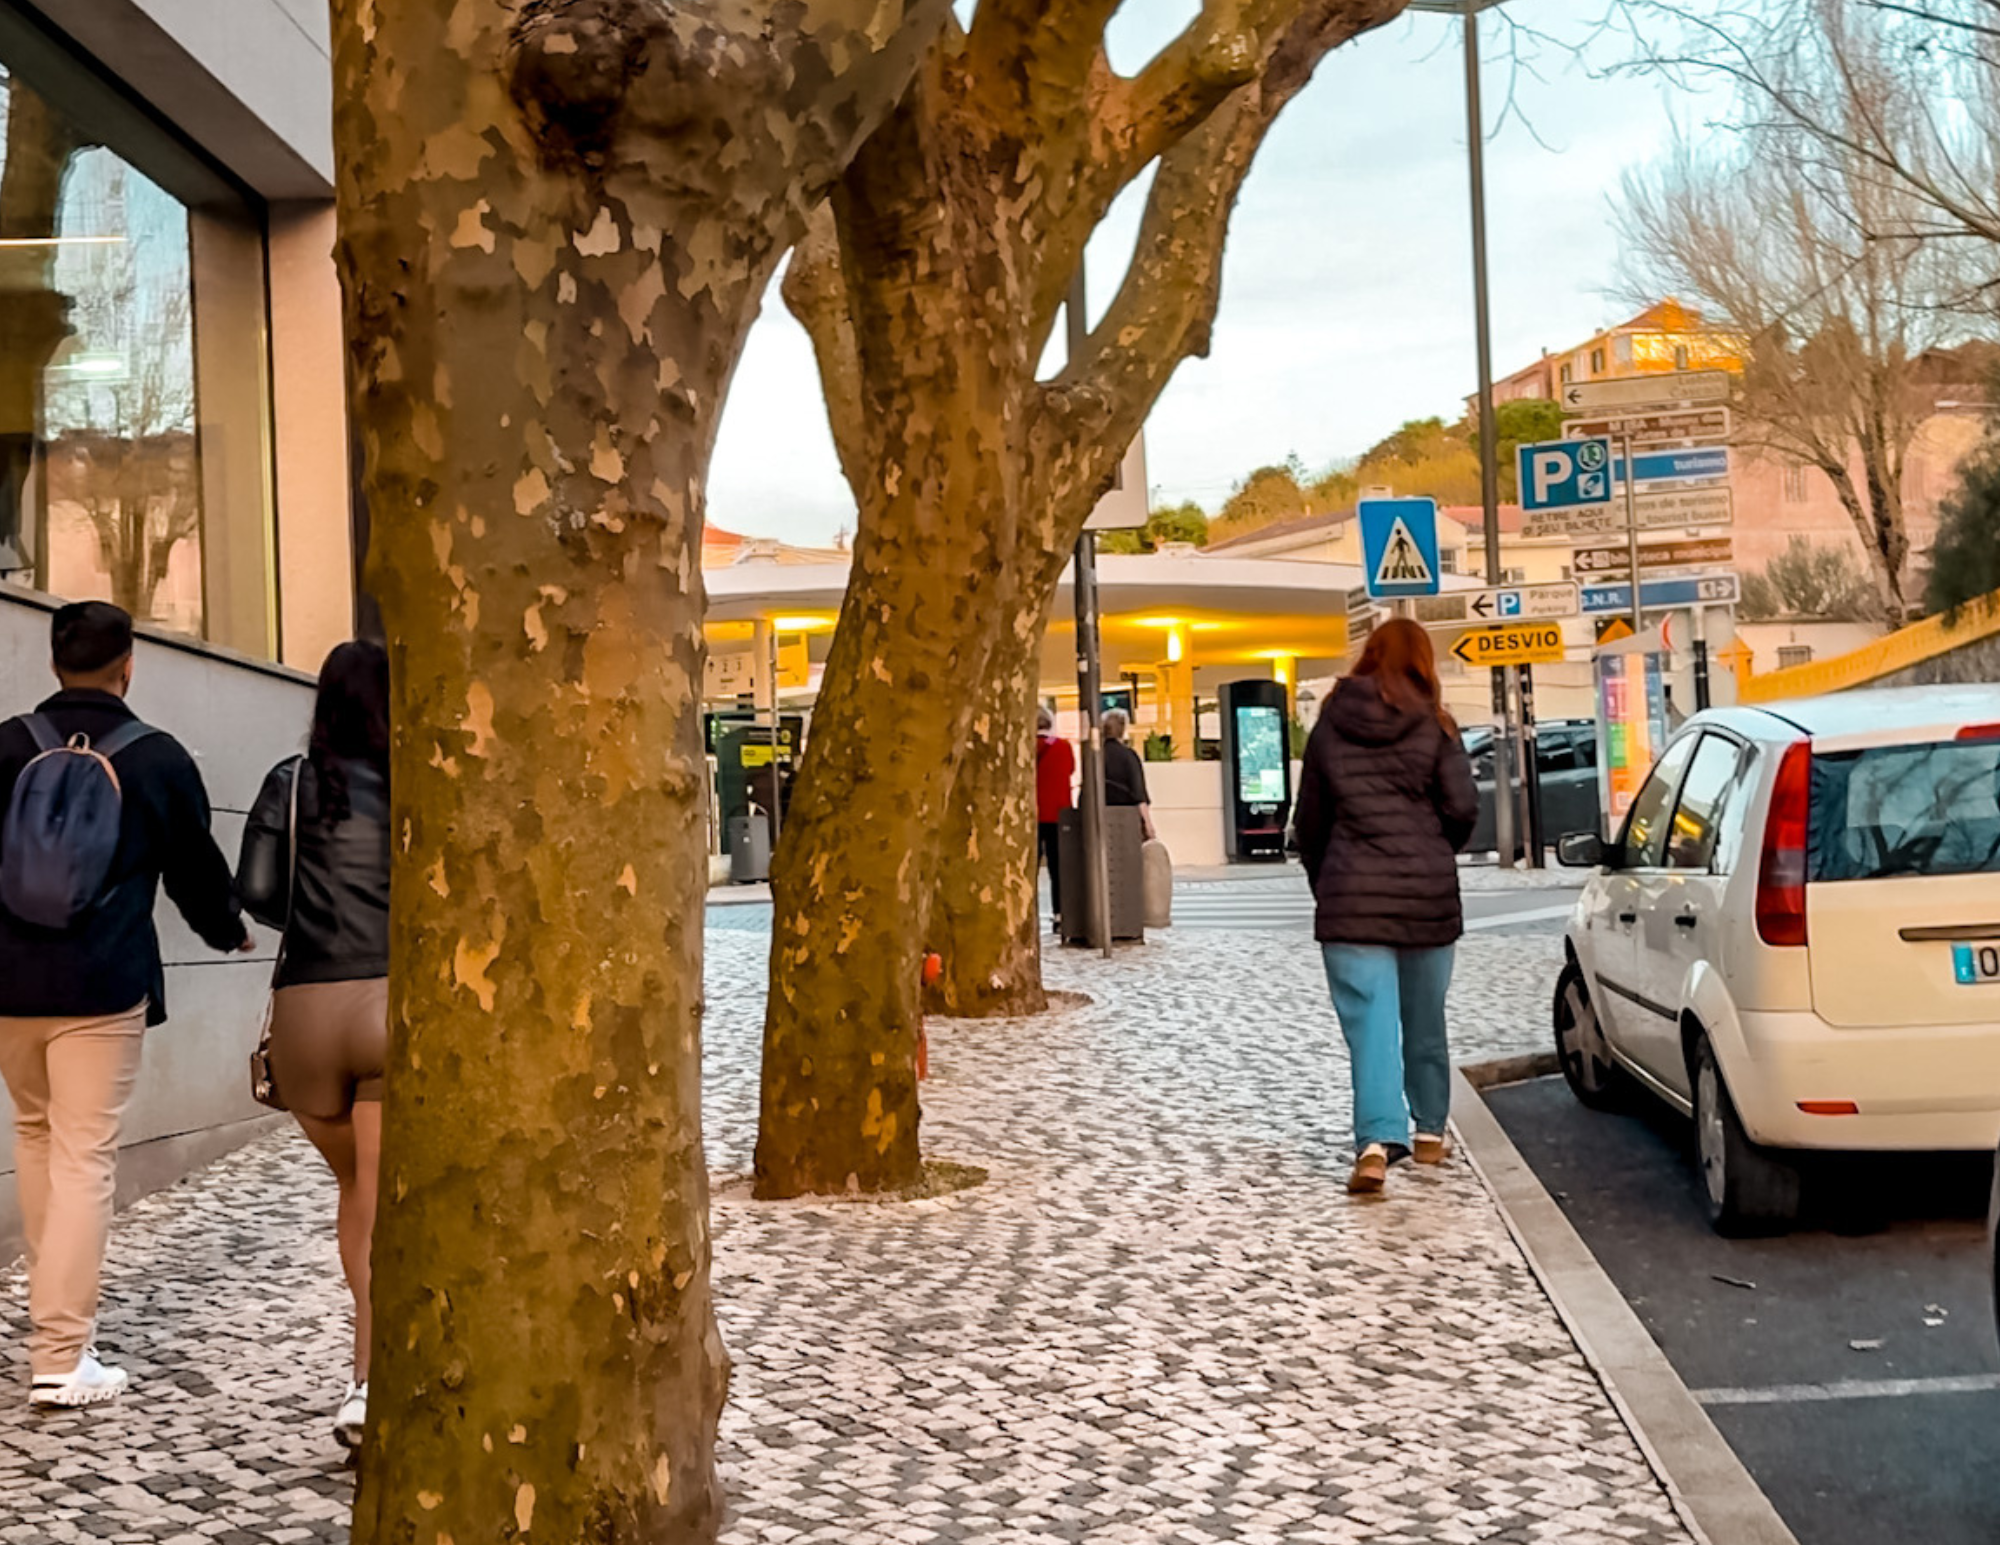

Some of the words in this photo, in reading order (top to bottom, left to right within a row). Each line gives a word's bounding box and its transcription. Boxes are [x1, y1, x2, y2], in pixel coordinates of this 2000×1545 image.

[1674, 456, 1726, 471] turismo
[1533, 450, 1573, 503] P
[1659, 496, 1676, 508] de
[1530, 511, 1570, 523] RETIRE
[1577, 507, 1604, 518] AQUI
[1646, 512, 1688, 524] tourist
[1691, 509, 1728, 521] buses
[1529, 589, 1573, 599] Parque
[1478, 631, 1559, 652] DESVIO
